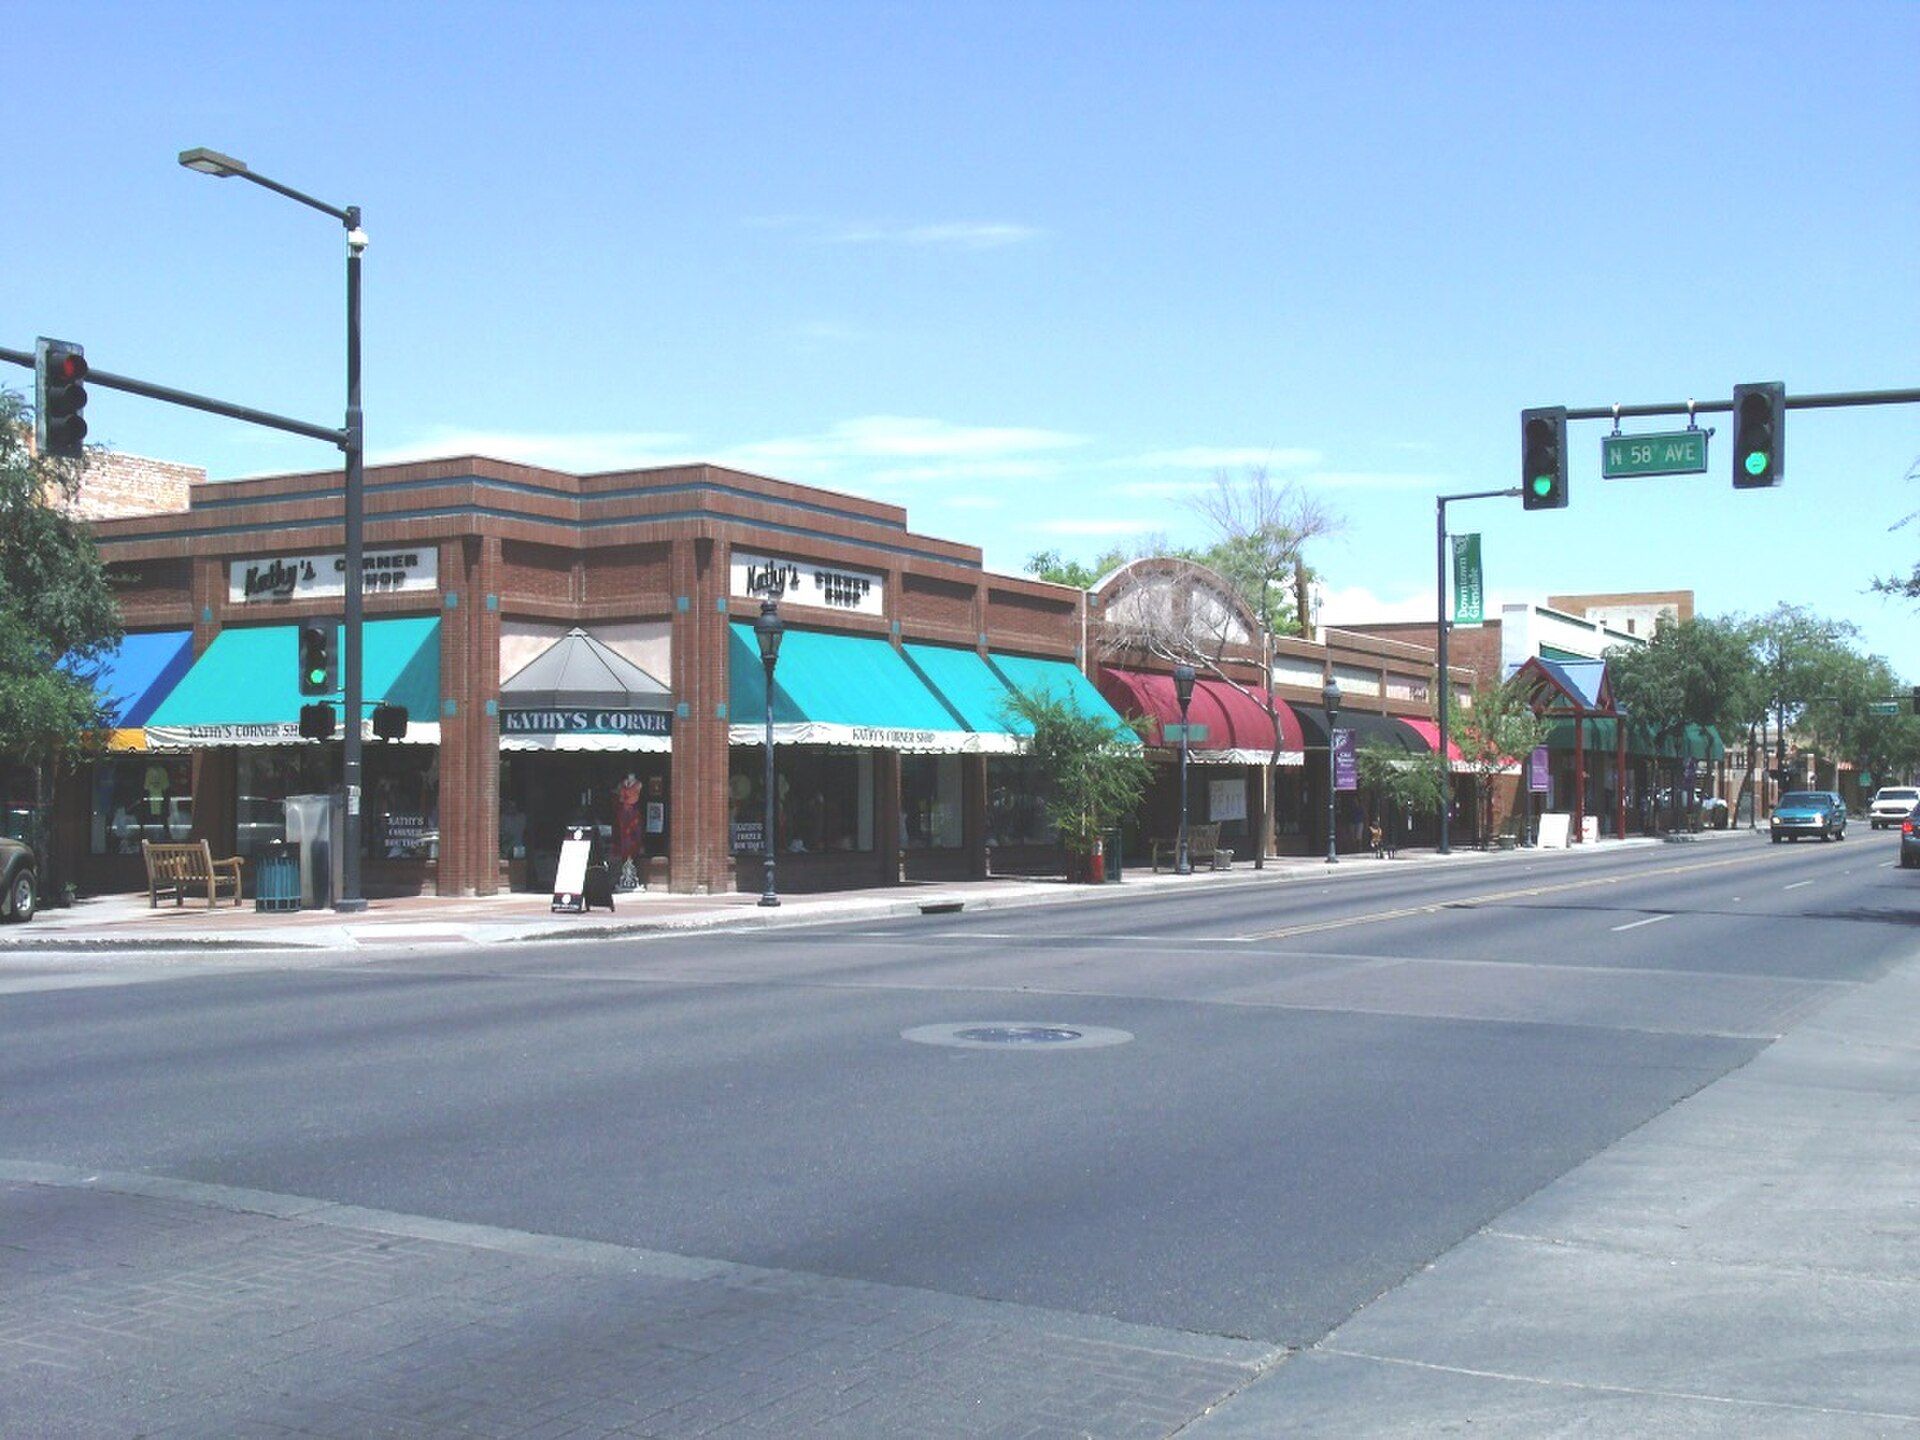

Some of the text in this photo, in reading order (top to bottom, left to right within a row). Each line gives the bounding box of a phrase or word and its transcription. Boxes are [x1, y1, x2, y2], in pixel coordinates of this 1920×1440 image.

[1610, 447, 1622, 466] N
[1664, 442, 1696, 462] AVE
[334, 554, 419, 572] CRNER
[746, 559, 800, 597] Kathy's
[1457, 557, 1469, 618] Downtown
[188, 724, 232, 739] KATHY'S
[235, 724, 280, 738] CORNER
[506, 711, 667, 731] KATHY'S CORNER
